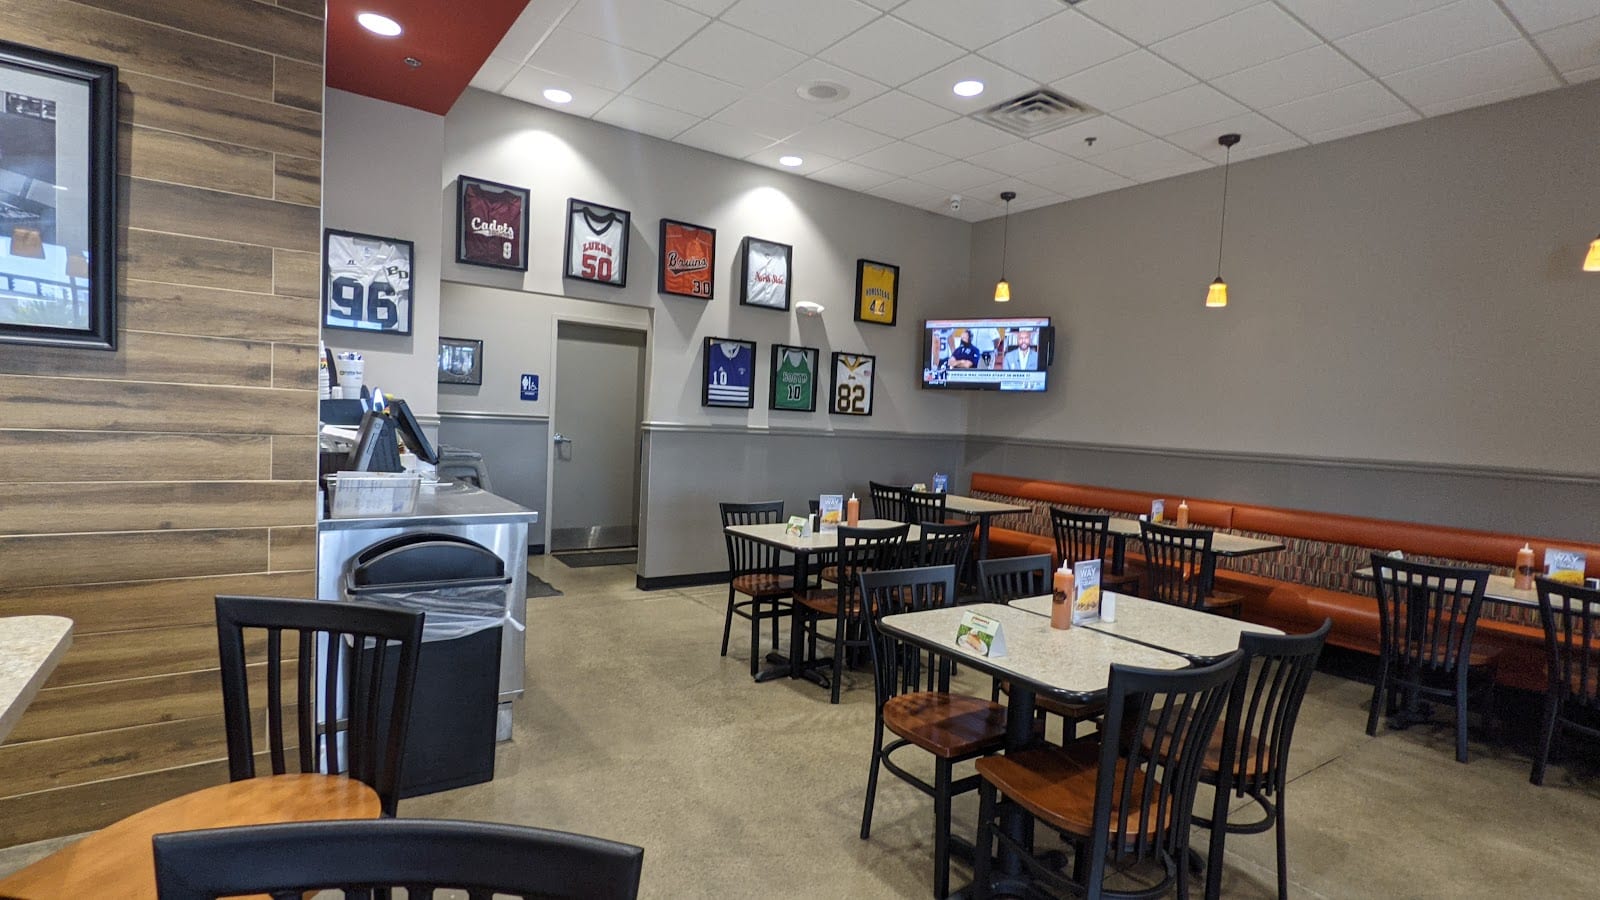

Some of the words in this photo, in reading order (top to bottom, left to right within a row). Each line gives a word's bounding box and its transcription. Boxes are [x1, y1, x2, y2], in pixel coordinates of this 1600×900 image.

[471, 217, 514, 239] Cadets
[582, 254, 612, 281] 50
[667, 251, 708, 268] Bruins
[692, 279, 711, 296] 30
[331, 276, 398, 328] 96
[869, 298, 886, 316] 44
[713, 370, 727, 386] 10
[787, 384, 801, 401] 10
[837, 383, 865, 412] 82
[1554, 552, 1579, 562] WAY
[1080, 566, 1097, 578] WAY
